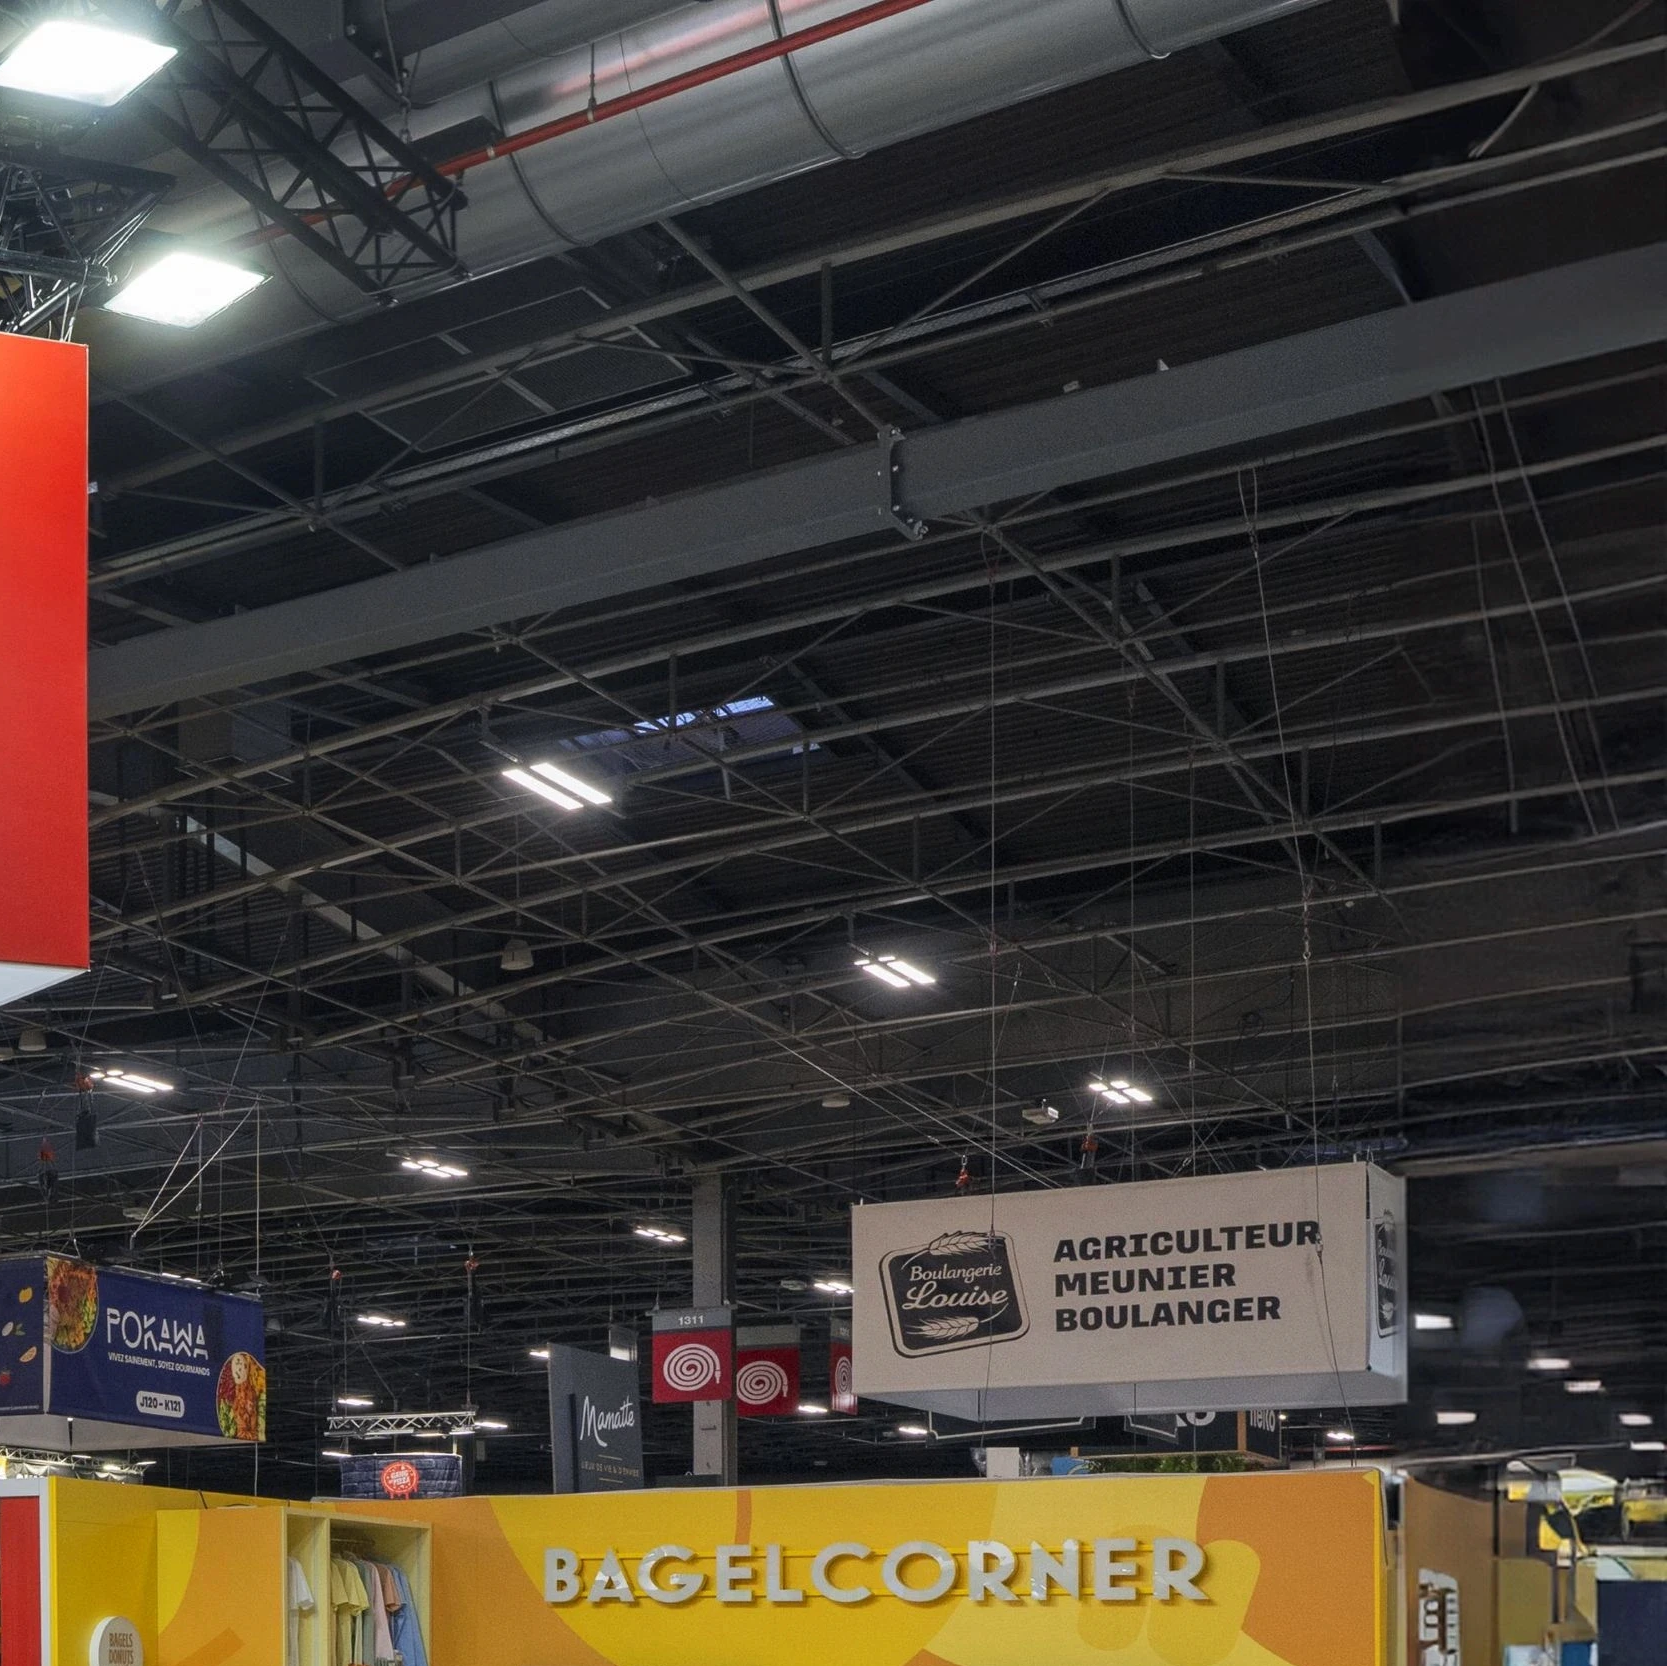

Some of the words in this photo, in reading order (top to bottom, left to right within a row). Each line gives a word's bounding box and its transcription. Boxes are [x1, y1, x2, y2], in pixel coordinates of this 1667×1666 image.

[1053, 1220, 1321, 1263] AGRICULTEUR
[909, 1263, 1003, 1284] Boulangerie
[1055, 1263, 1237, 1298] MEUNIER
[901, 1281, 1009, 1310] Louise
[677, 1314, 705, 1326] 1311
[1055, 1295, 1282, 1332] BOULANGER
[106, 1307, 209, 1361] POKAWA
[139, 1396, 158, 1409] J120
